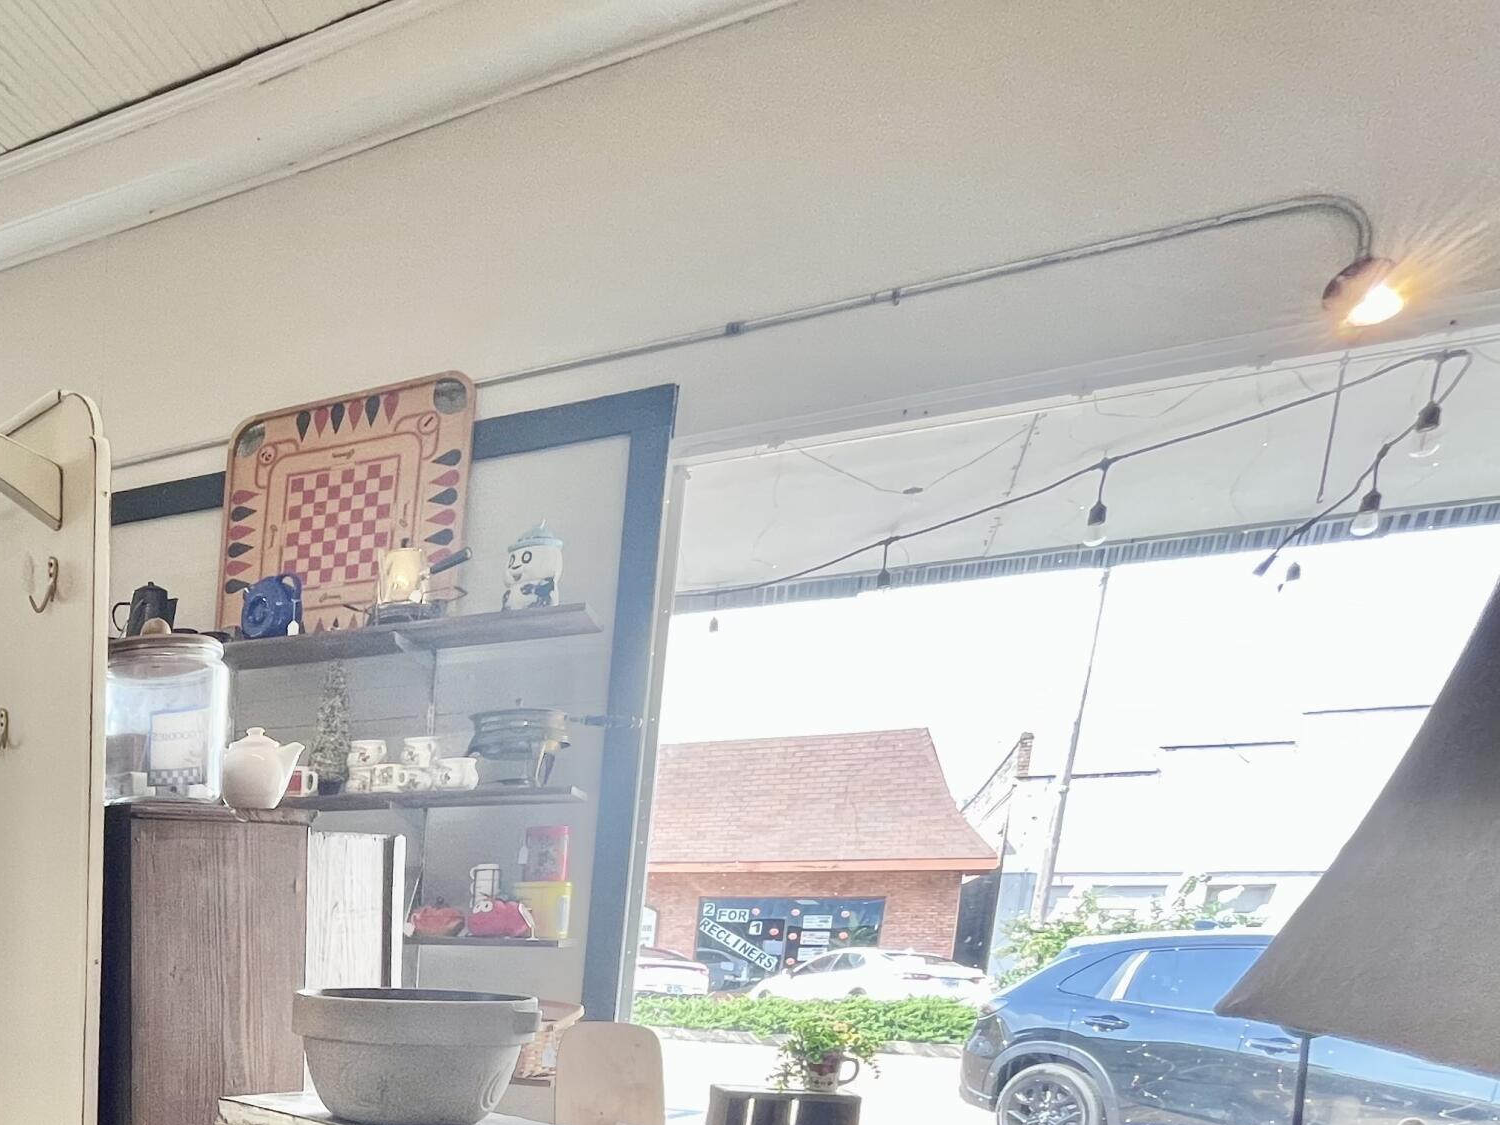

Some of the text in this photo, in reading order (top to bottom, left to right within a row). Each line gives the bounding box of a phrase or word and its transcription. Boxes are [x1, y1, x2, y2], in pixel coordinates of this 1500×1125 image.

[705, 904, 762, 934] 2 FOR 1
[700, 919, 775, 969] RECLINERS
